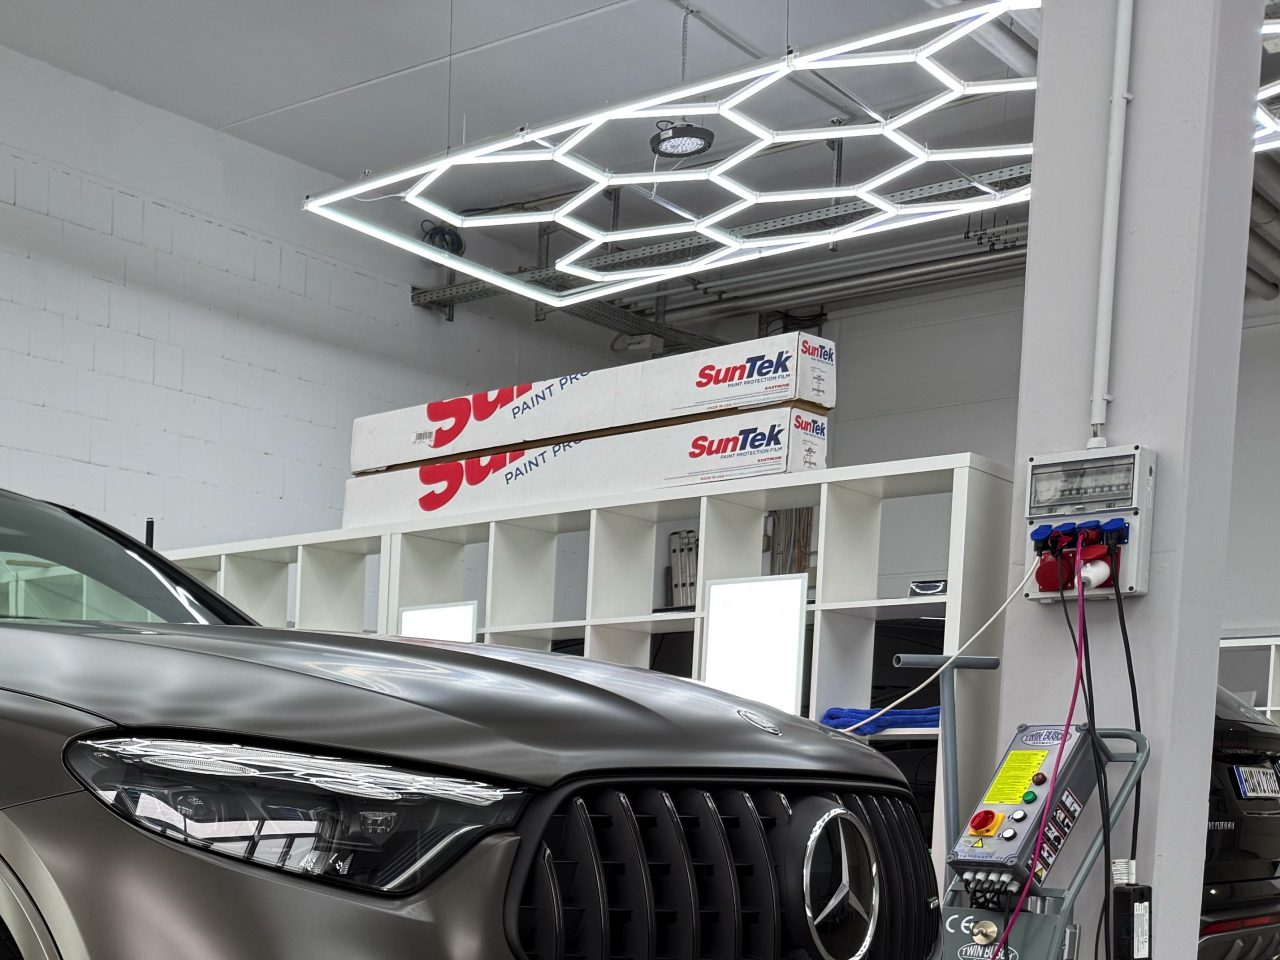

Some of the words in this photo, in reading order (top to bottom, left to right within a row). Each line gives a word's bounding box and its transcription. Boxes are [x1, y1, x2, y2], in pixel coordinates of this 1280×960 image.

[511, 384, 554, 419] PAINT
[504, 451, 547, 485] PAINT
[962, 945, 983, 957] TWIN
